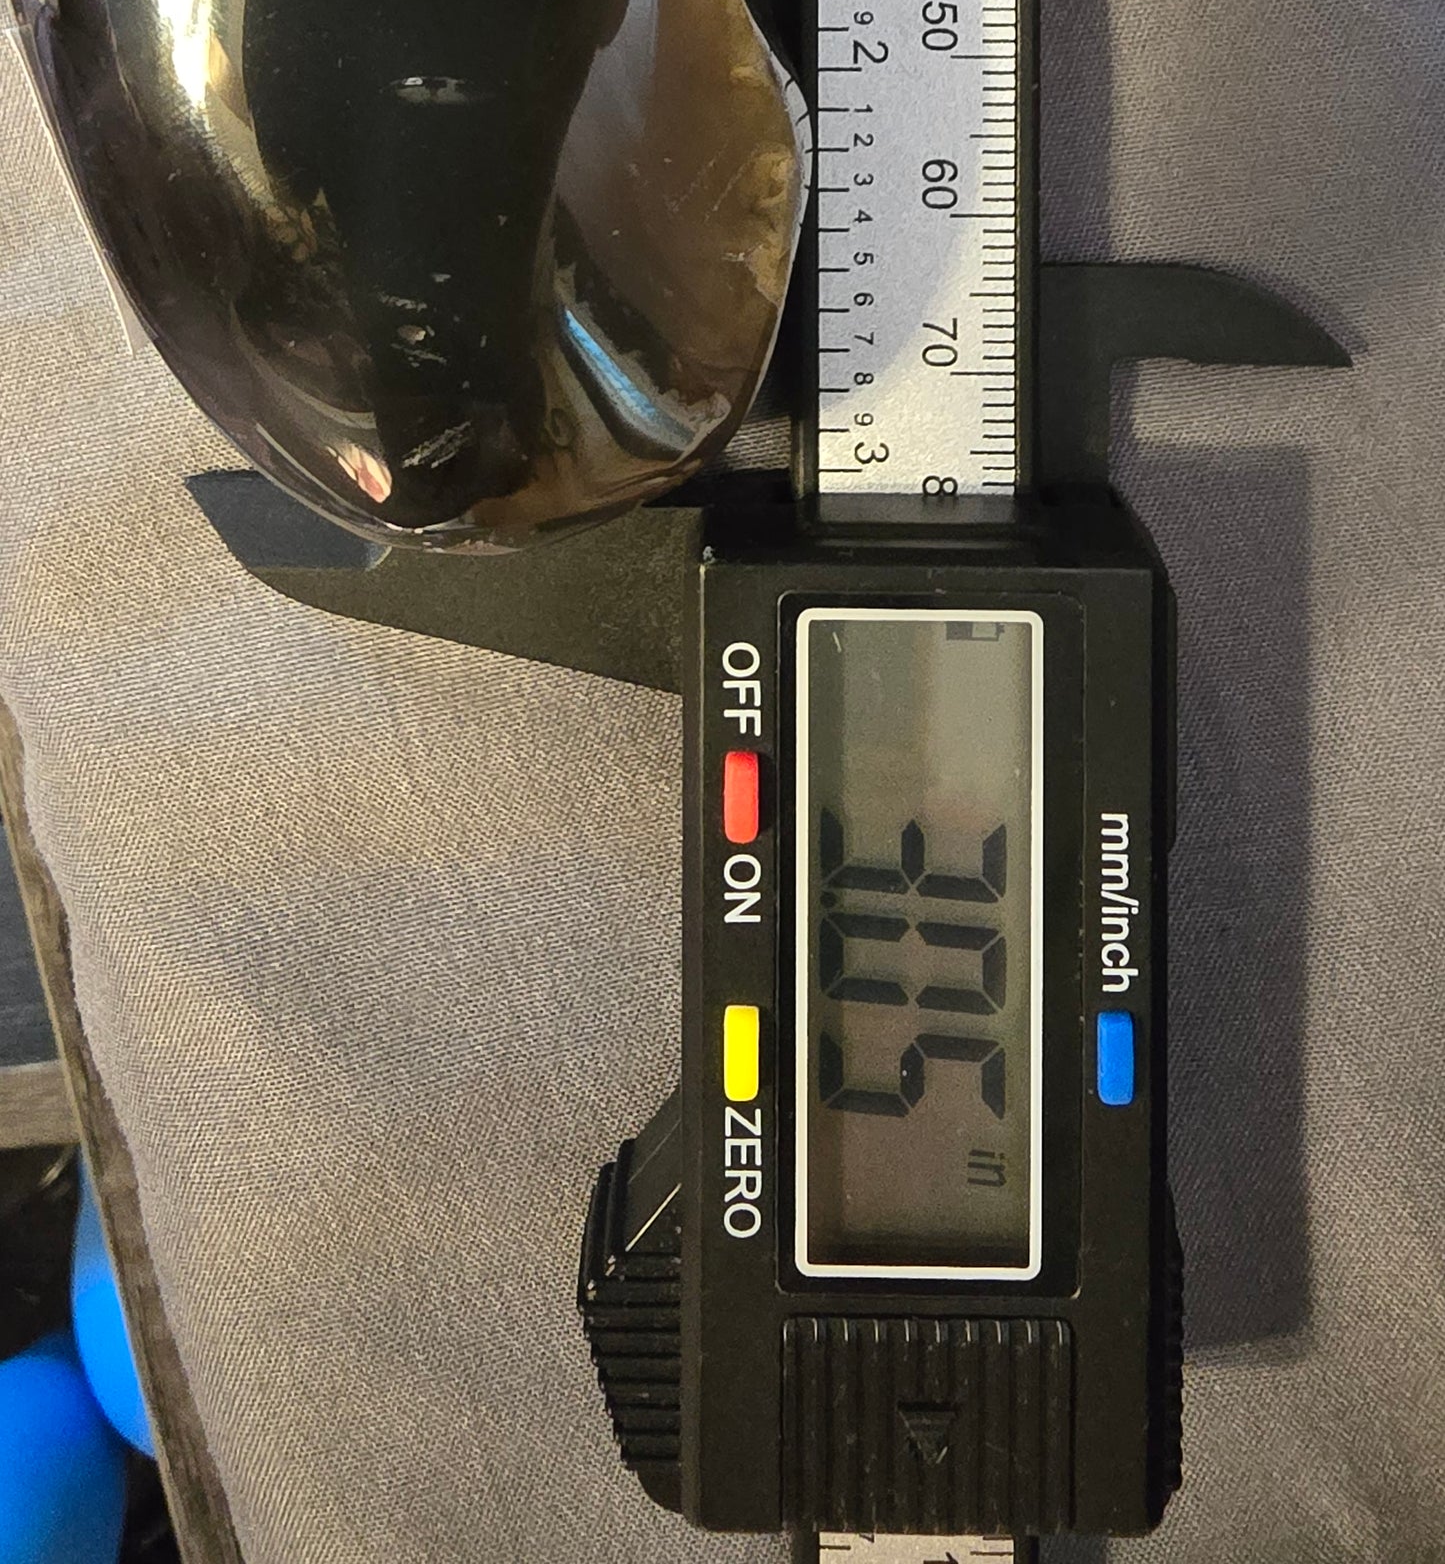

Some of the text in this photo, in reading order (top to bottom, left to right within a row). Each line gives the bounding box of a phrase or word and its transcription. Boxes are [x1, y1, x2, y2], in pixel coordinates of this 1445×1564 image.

[853, 10, 874, 26] 9
[922, 1, 959, 52] 50
[853, 39, 889, 65] 2
[853, 103, 875, 114] 1
[853, 132, 875, 148] 2
[853, 172, 875, 187] 3
[922, 159, 959, 210] 60
[853, 208, 875, 224] 4
[853, 251, 875, 266] 5
[853, 292, 875, 307] 6
[853, 331, 875, 346] 7
[922, 318, 959, 368] 70
[853, 371, 875, 386] 8
[853, 412, 875, 427] 9
[853, 441, 890, 465] 3
[1101, 813, 1140, 993] mm/inch
[722, 642, 762, 1239] OFF ON ZERO
[818, 807, 1007, 1187] 3.05 in
